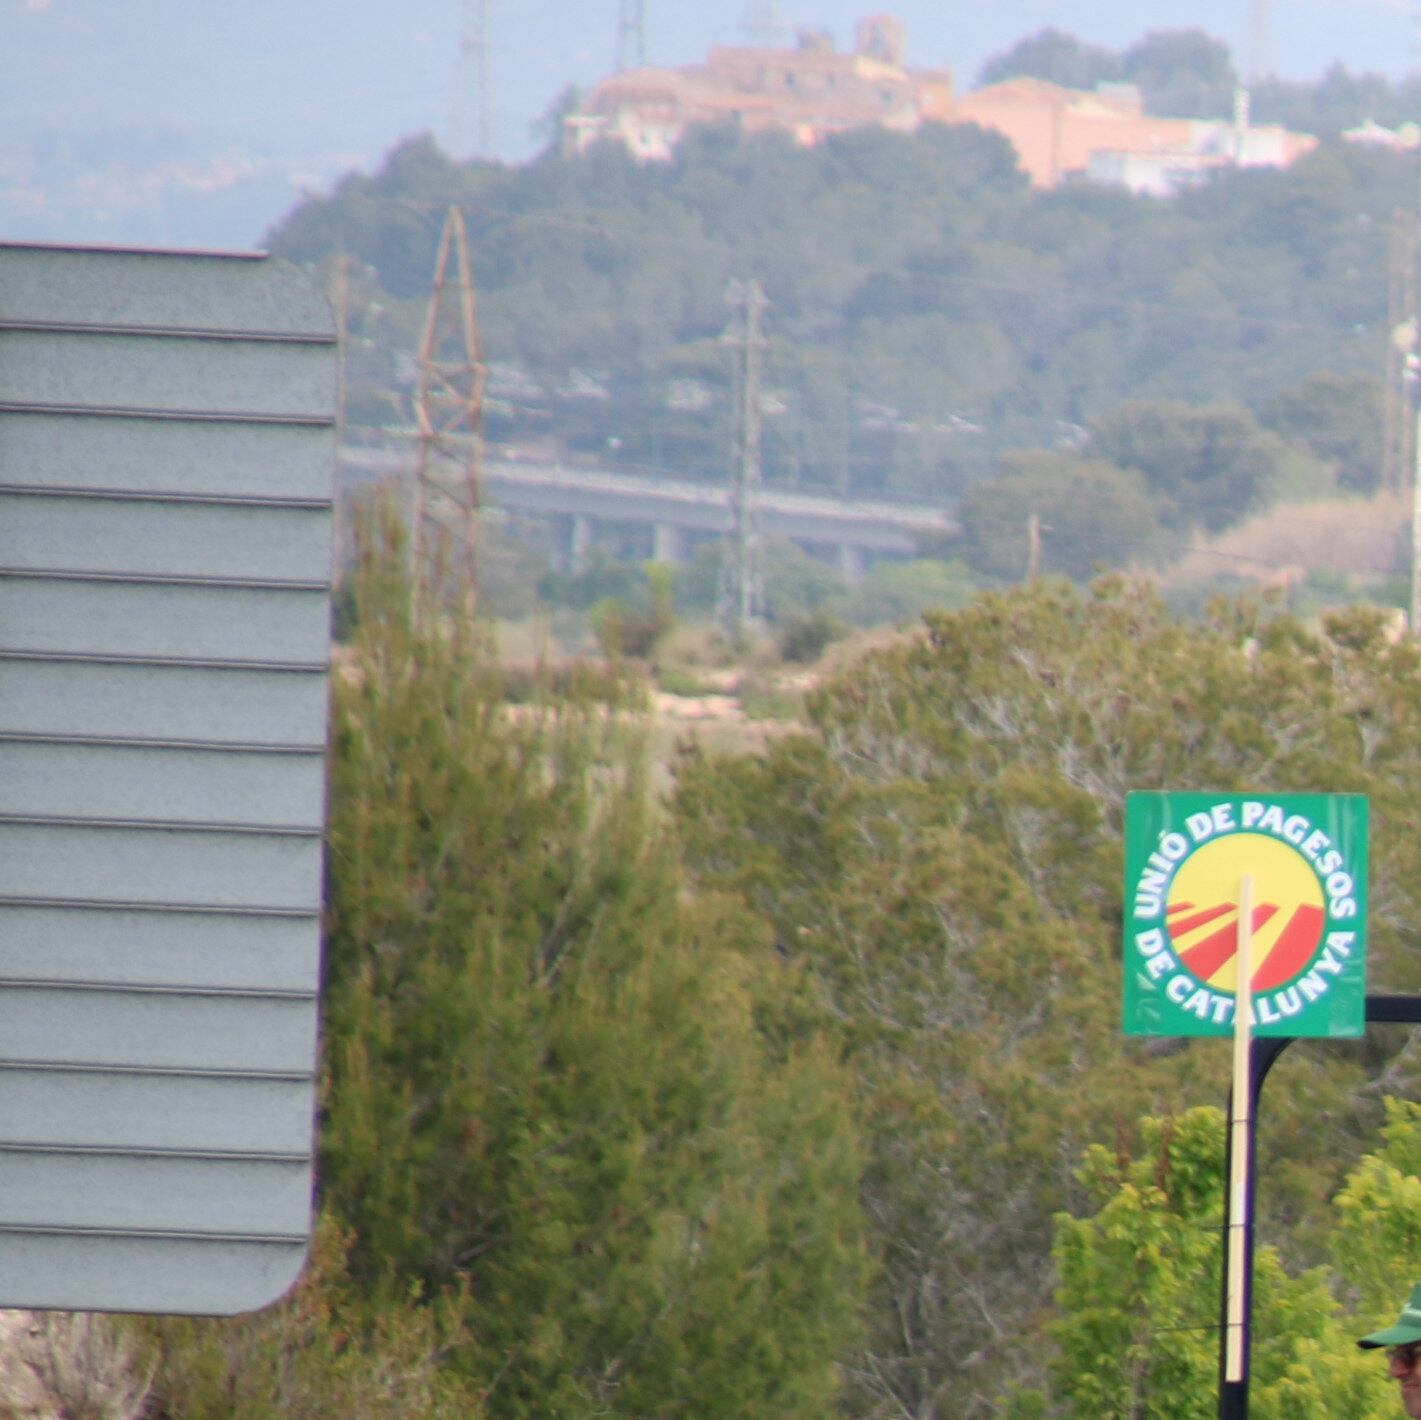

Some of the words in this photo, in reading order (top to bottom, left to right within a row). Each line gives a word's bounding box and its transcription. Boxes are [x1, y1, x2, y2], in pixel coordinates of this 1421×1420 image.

[1134, 829, 1189, 919] UNIÓ
[1185, 803, 1236, 841] DE
[1241, 801, 1357, 919] PAGESOS
[1135, 927, 1176, 980] DE
